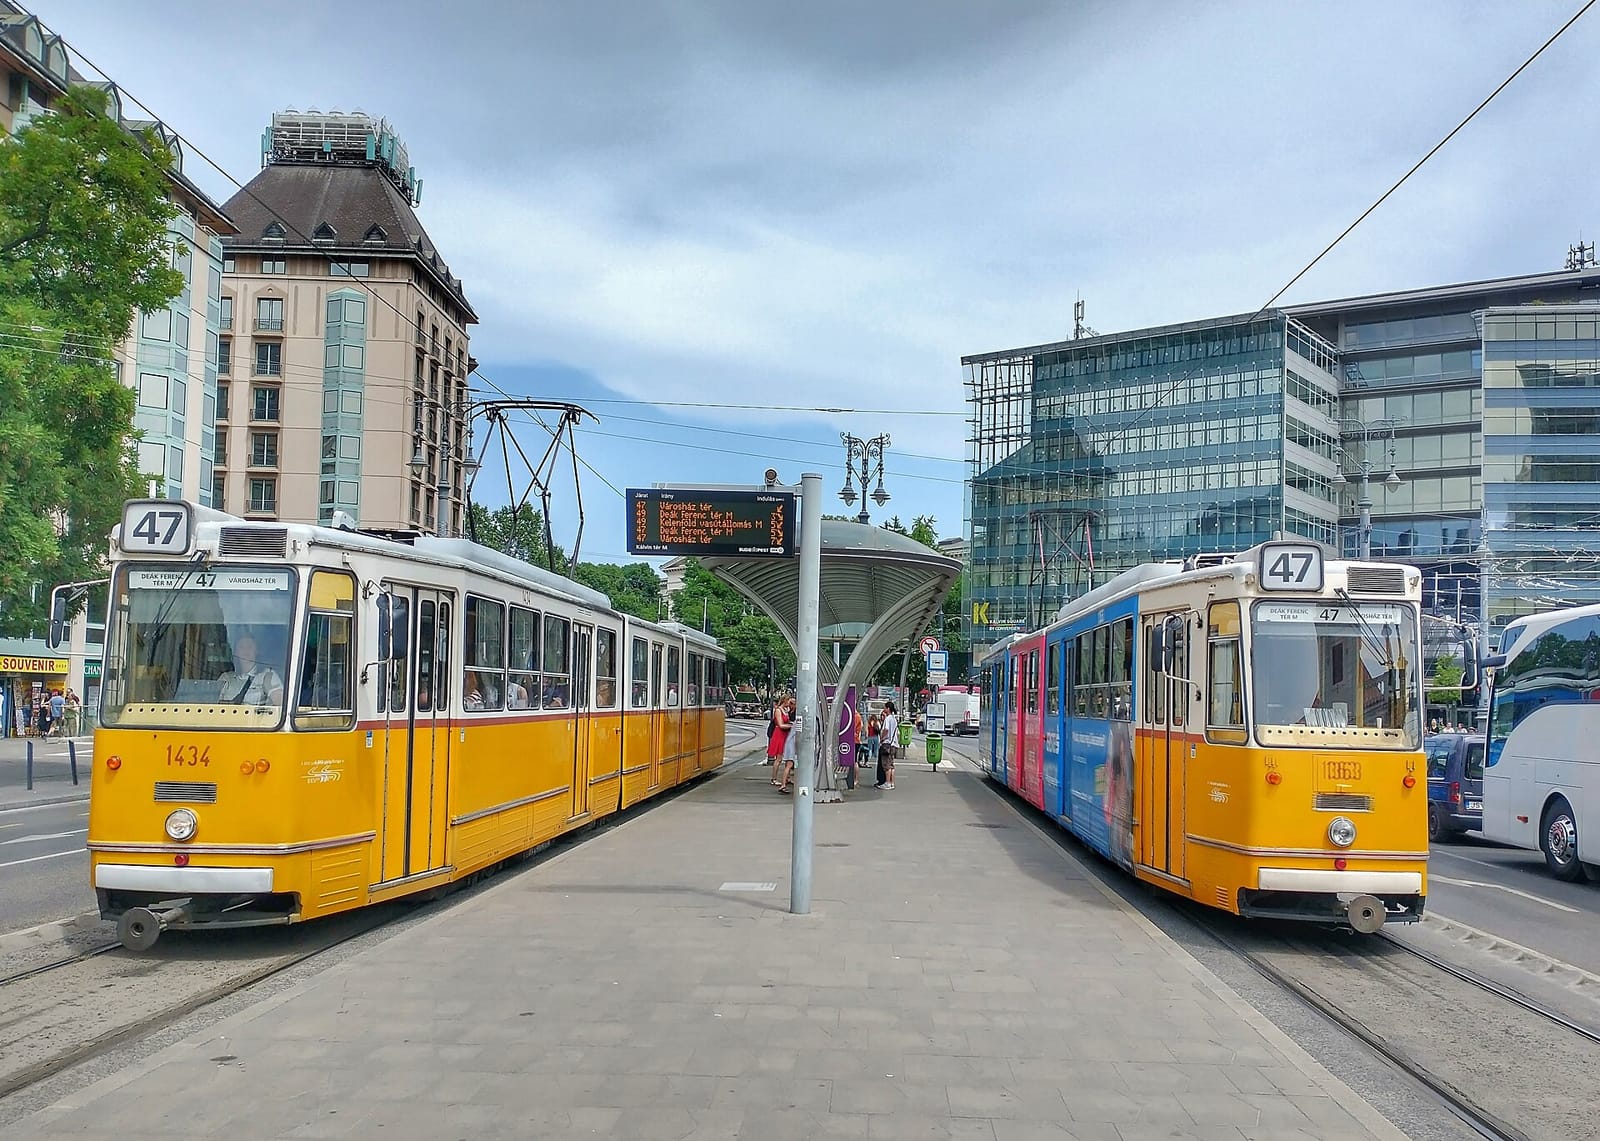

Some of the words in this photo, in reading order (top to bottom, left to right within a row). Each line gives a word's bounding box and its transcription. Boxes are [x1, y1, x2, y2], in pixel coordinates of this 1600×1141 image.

[636, 501, 646, 509] 47
[659, 501, 696, 511] Városház
[700, 502, 713, 511] tér
[659, 510, 678, 518] Deák
[681, 510, 707, 519] Ferenc
[711, 511, 723, 519] tér
[726, 512, 733, 520] M
[133, 511, 184, 545] 47
[659, 518, 696, 527] Kelenföld
[699, 518, 752, 528] vasútállomás
[755, 520, 762, 528] M
[636, 525, 646, 533] 47
[659, 526, 678, 535] Deák
[681, 527, 707, 536] Ferenc
[711, 527, 723, 536] tér
[726, 528, 733, 536] M
[636, 533, 646, 542] 47
[659, 534, 696, 543] Városház
[700, 535, 713, 544] tér
[1268, 552, 1314, 583] 47
[141, 571, 159, 580] DEÁK
[196, 573, 216, 587] 47
[228, 574, 263, 584] VÁROSHÁZ
[265, 576, 276, 584] TÉR
[153, 579, 165, 587] TÉR
[973, 602, 990, 624] K
[1270, 607, 1286, 615] DEÁK
[1319, 608, 1339, 621] 47
[2, 657, 55, 672] SOUVENIR
[166, 744, 211, 768] 1434
